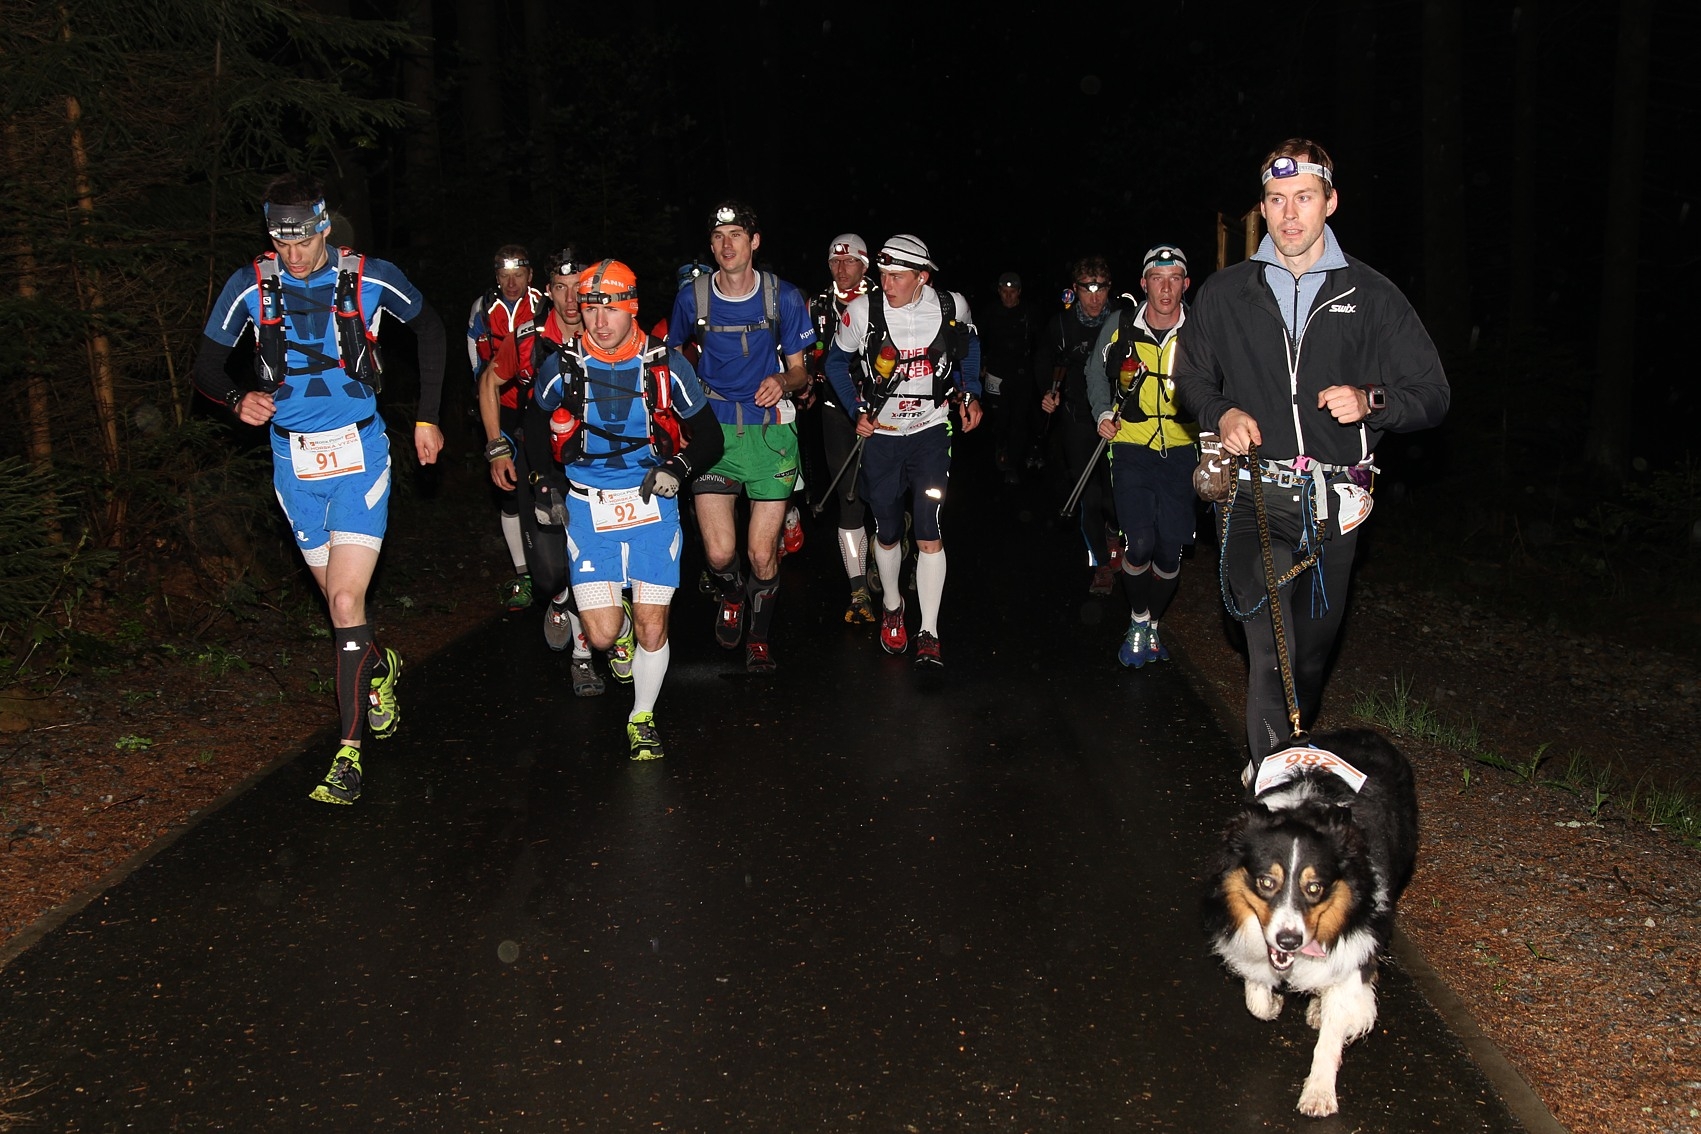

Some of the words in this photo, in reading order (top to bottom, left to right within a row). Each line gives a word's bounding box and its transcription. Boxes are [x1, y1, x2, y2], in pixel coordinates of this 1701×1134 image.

[899, 347, 923, 359] THE
[316, 451, 338, 471] 91
[699, 474, 726, 485] SURVIVAL
[614, 503, 637, 522] 92
